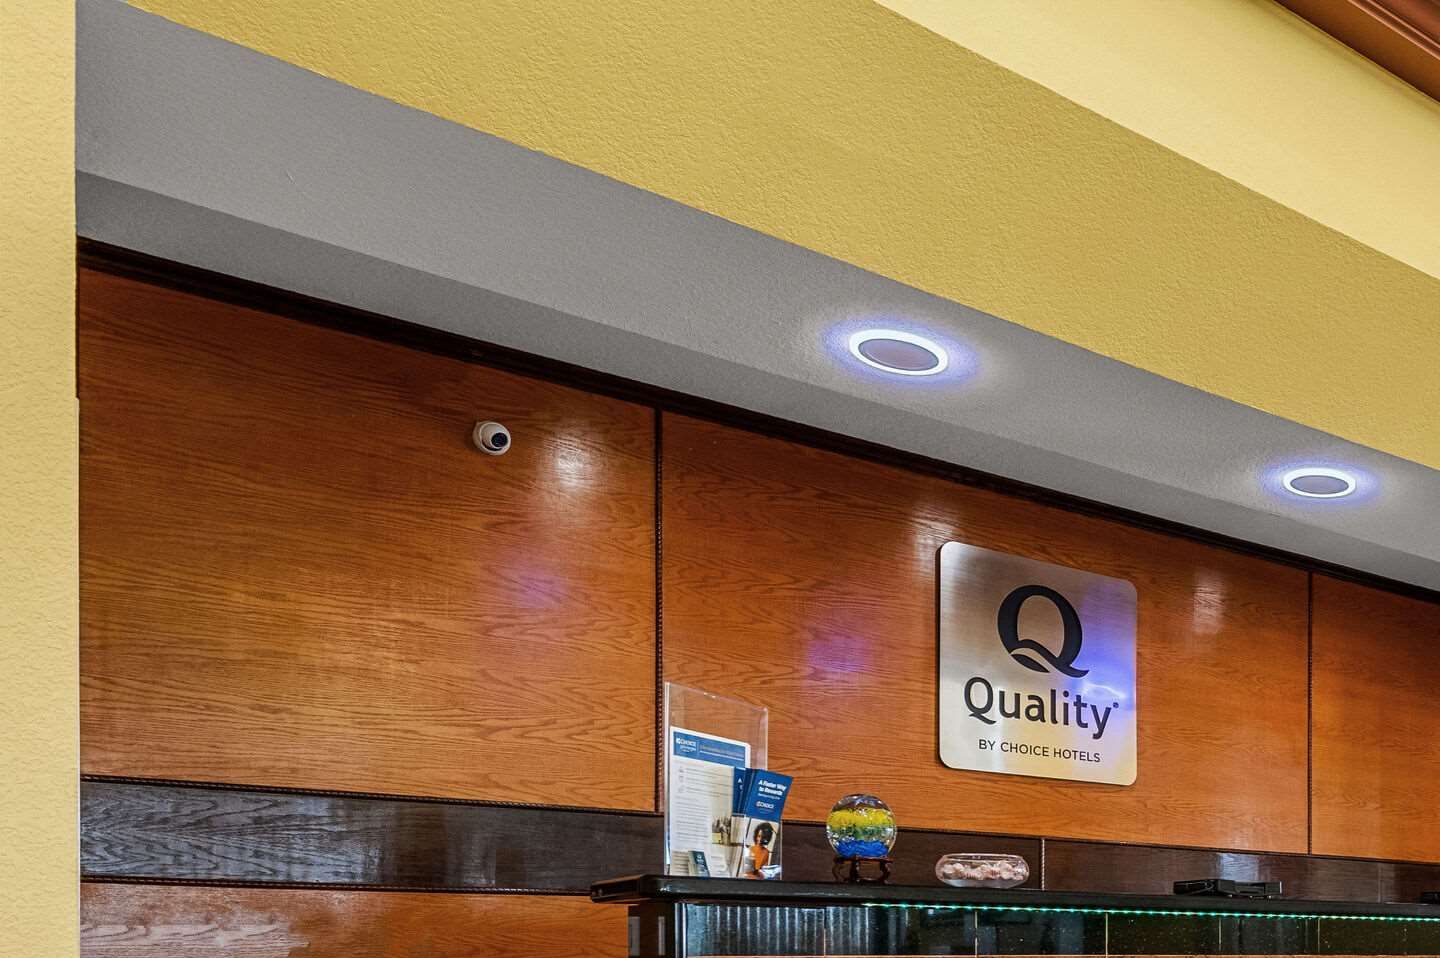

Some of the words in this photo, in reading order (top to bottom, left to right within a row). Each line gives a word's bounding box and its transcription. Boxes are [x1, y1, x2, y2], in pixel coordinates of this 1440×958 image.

[997, 584, 1090, 678] Q
[964, 676, 1112, 740] Quality
[978, 738, 996, 751] BY
[1000, 741, 1050, 757] CHOICE
[1053, 748, 1101, 763] HOTELS
